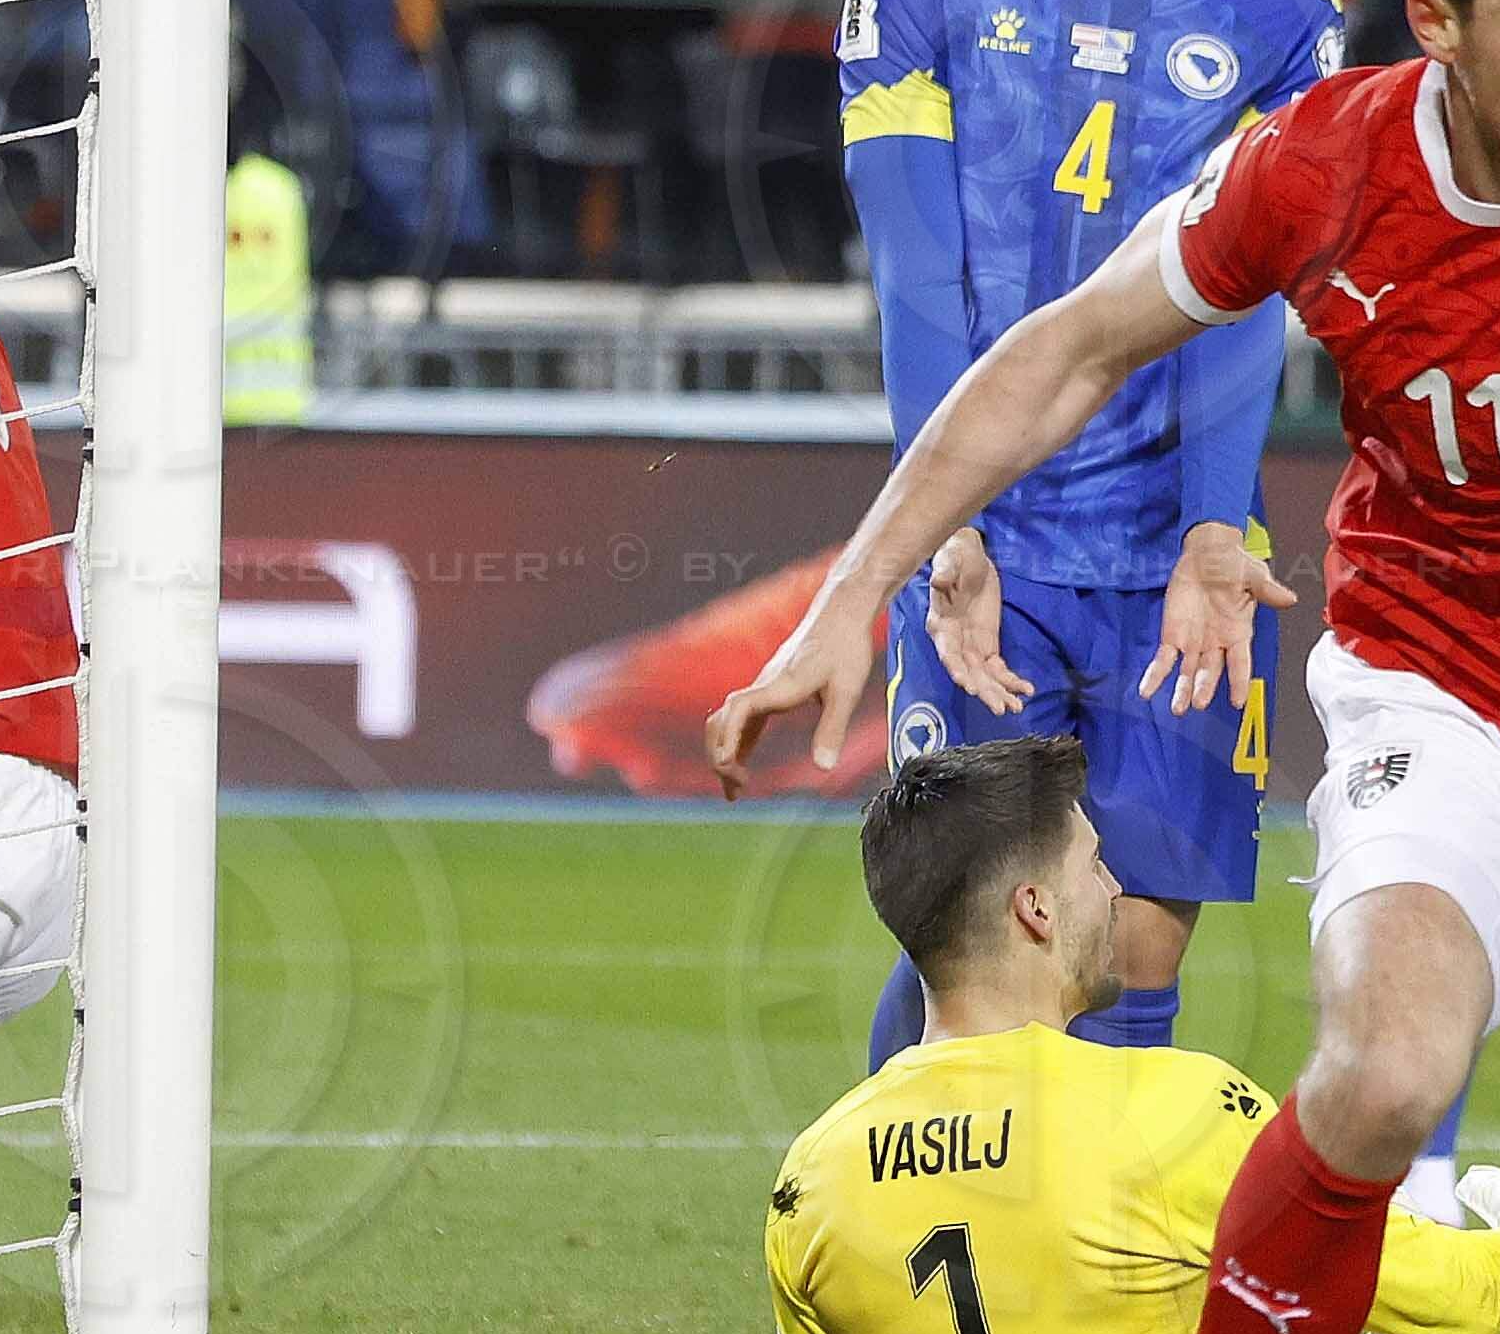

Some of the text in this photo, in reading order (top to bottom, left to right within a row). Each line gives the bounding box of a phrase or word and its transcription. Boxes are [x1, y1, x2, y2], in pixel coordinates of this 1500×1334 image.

[1053, 100, 1116, 214] 4
[1232, 678, 1270, 791] 4
[868, 1108, 1013, 1183] VASILJ
